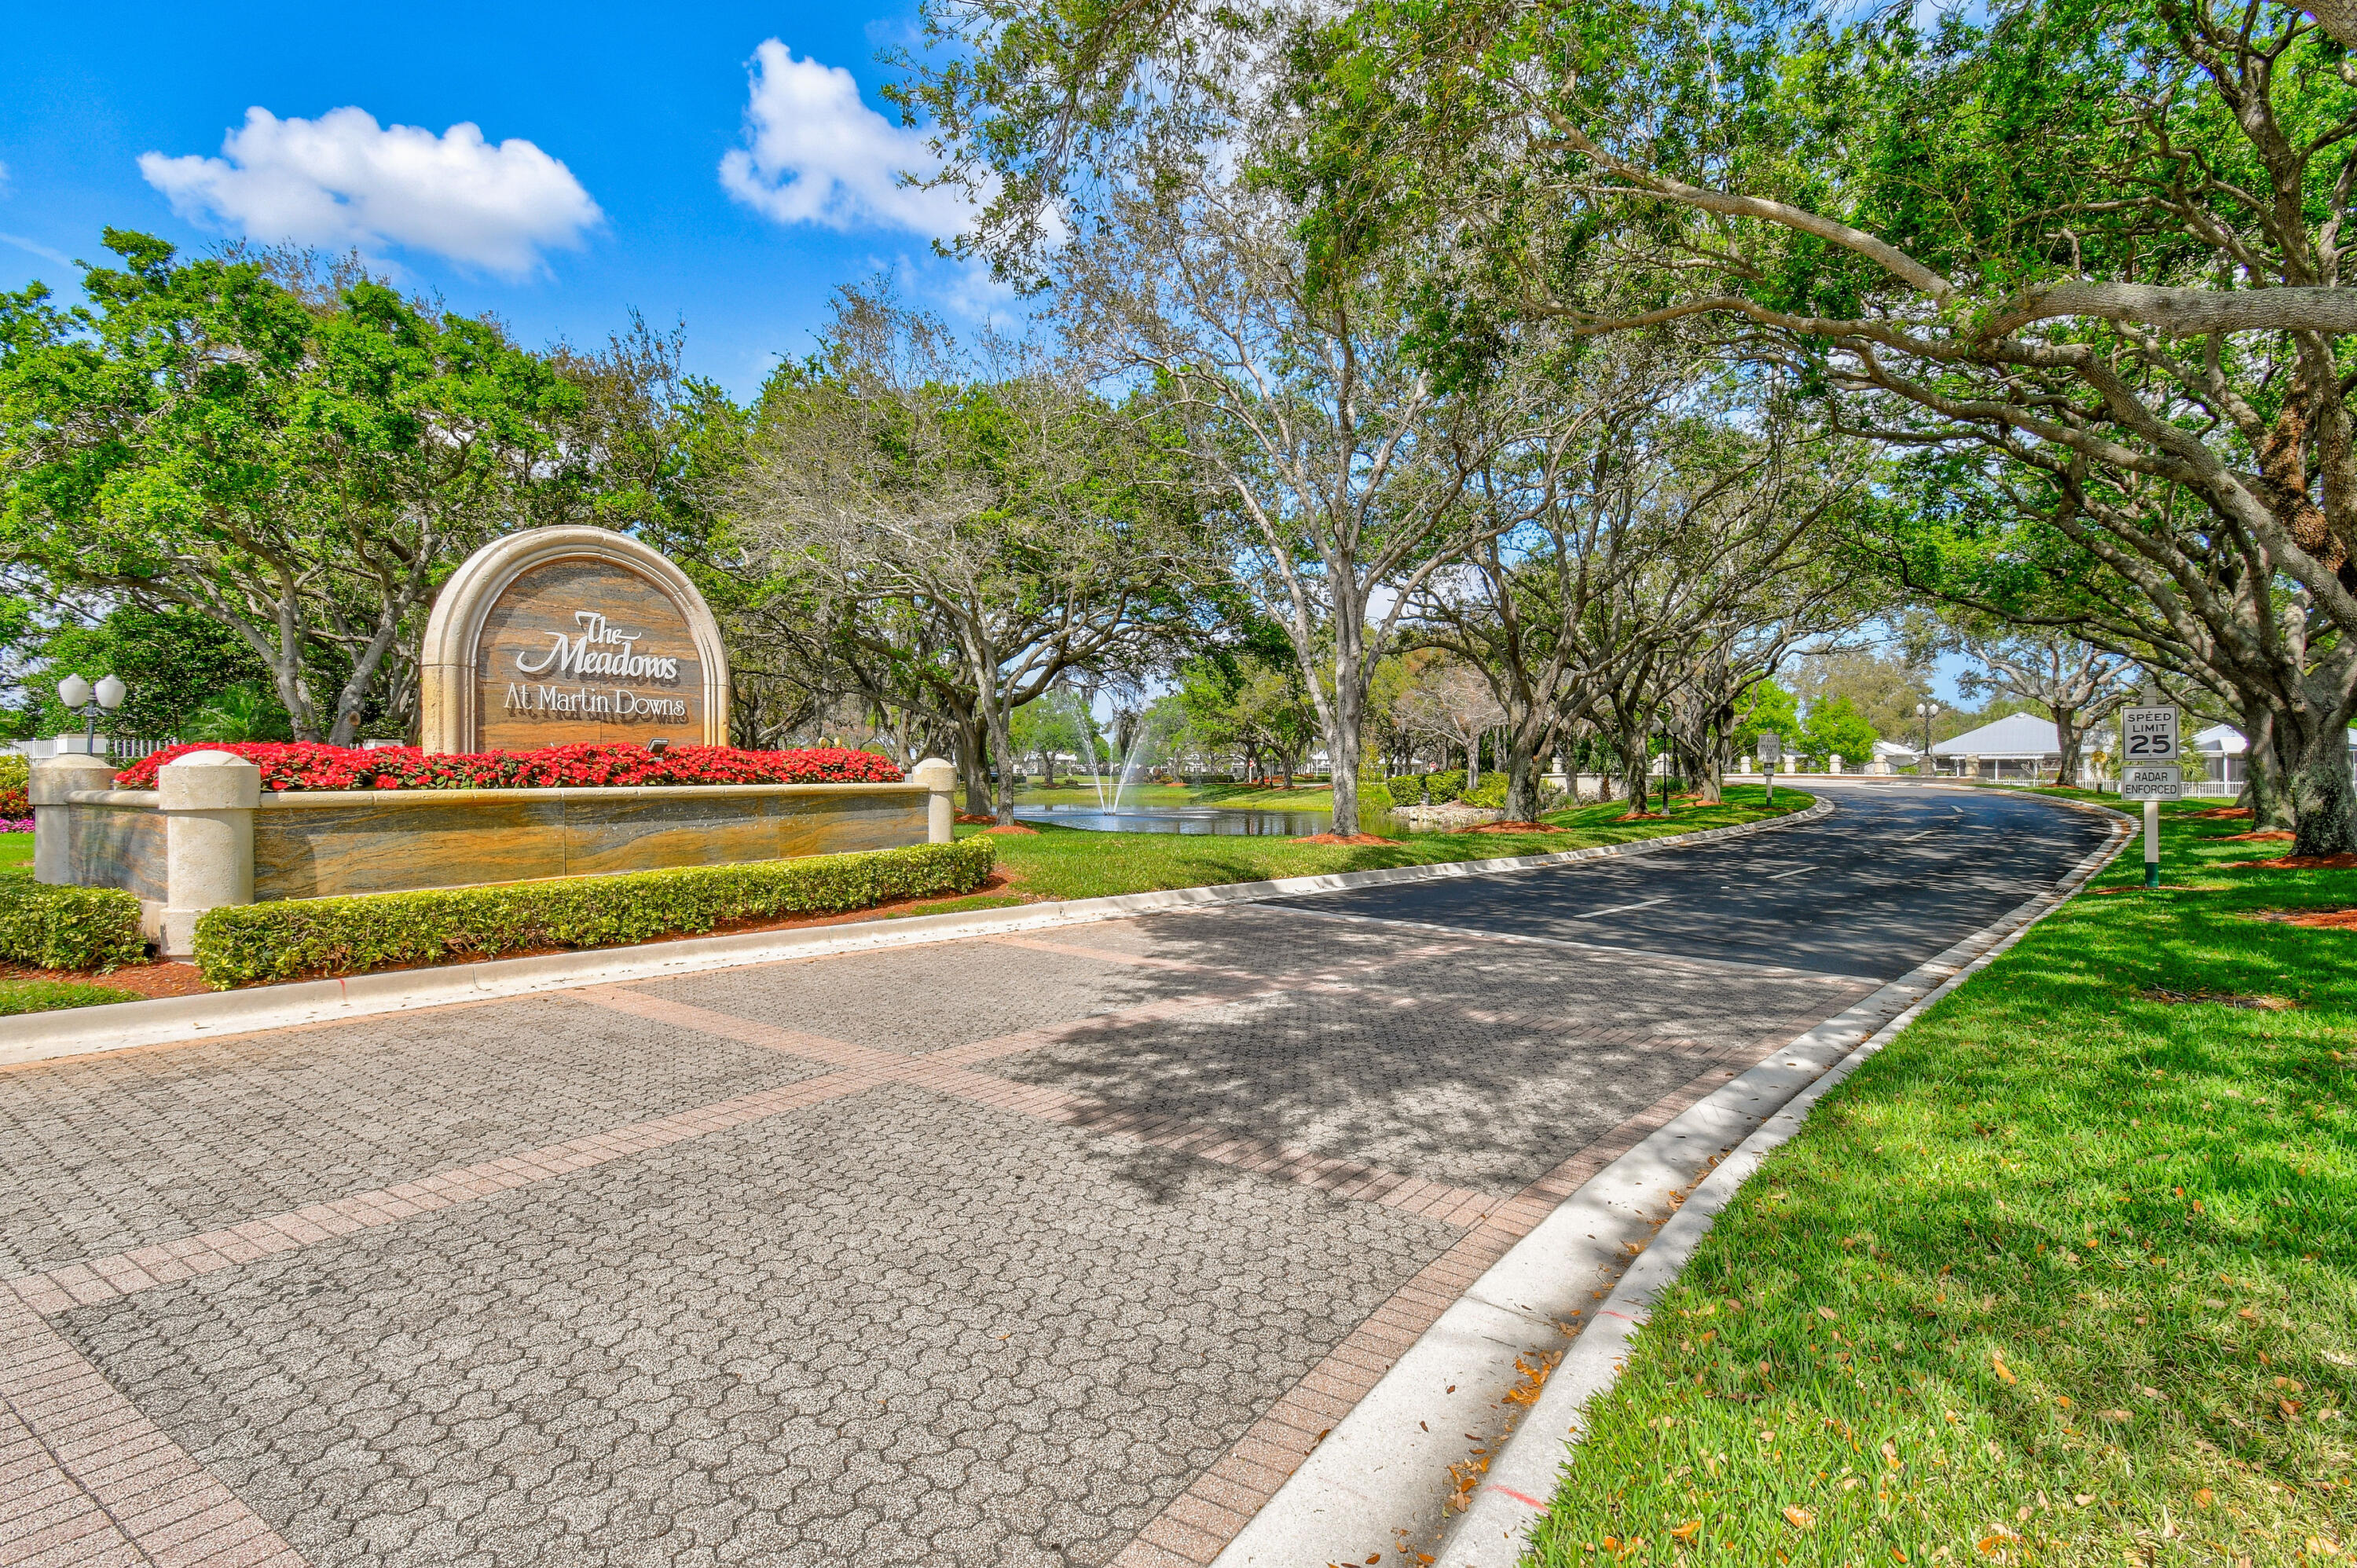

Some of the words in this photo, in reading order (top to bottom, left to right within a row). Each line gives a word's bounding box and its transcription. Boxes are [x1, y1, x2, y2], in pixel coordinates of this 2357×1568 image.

[575, 610, 642, 644] The
[515, 631, 677, 680] Meadows
[504, 682, 533, 710] At
[537, 684, 610, 713] Martin
[615, 690, 686, 716] Downs
[2127, 713, 2172, 722] SPEED
[2132, 724, 2168, 733] LIMIT
[2129, 735, 2171, 754] 25
[2134, 771, 2168, 782] RADAR
[2125, 784, 2177, 794] ENFORCED
